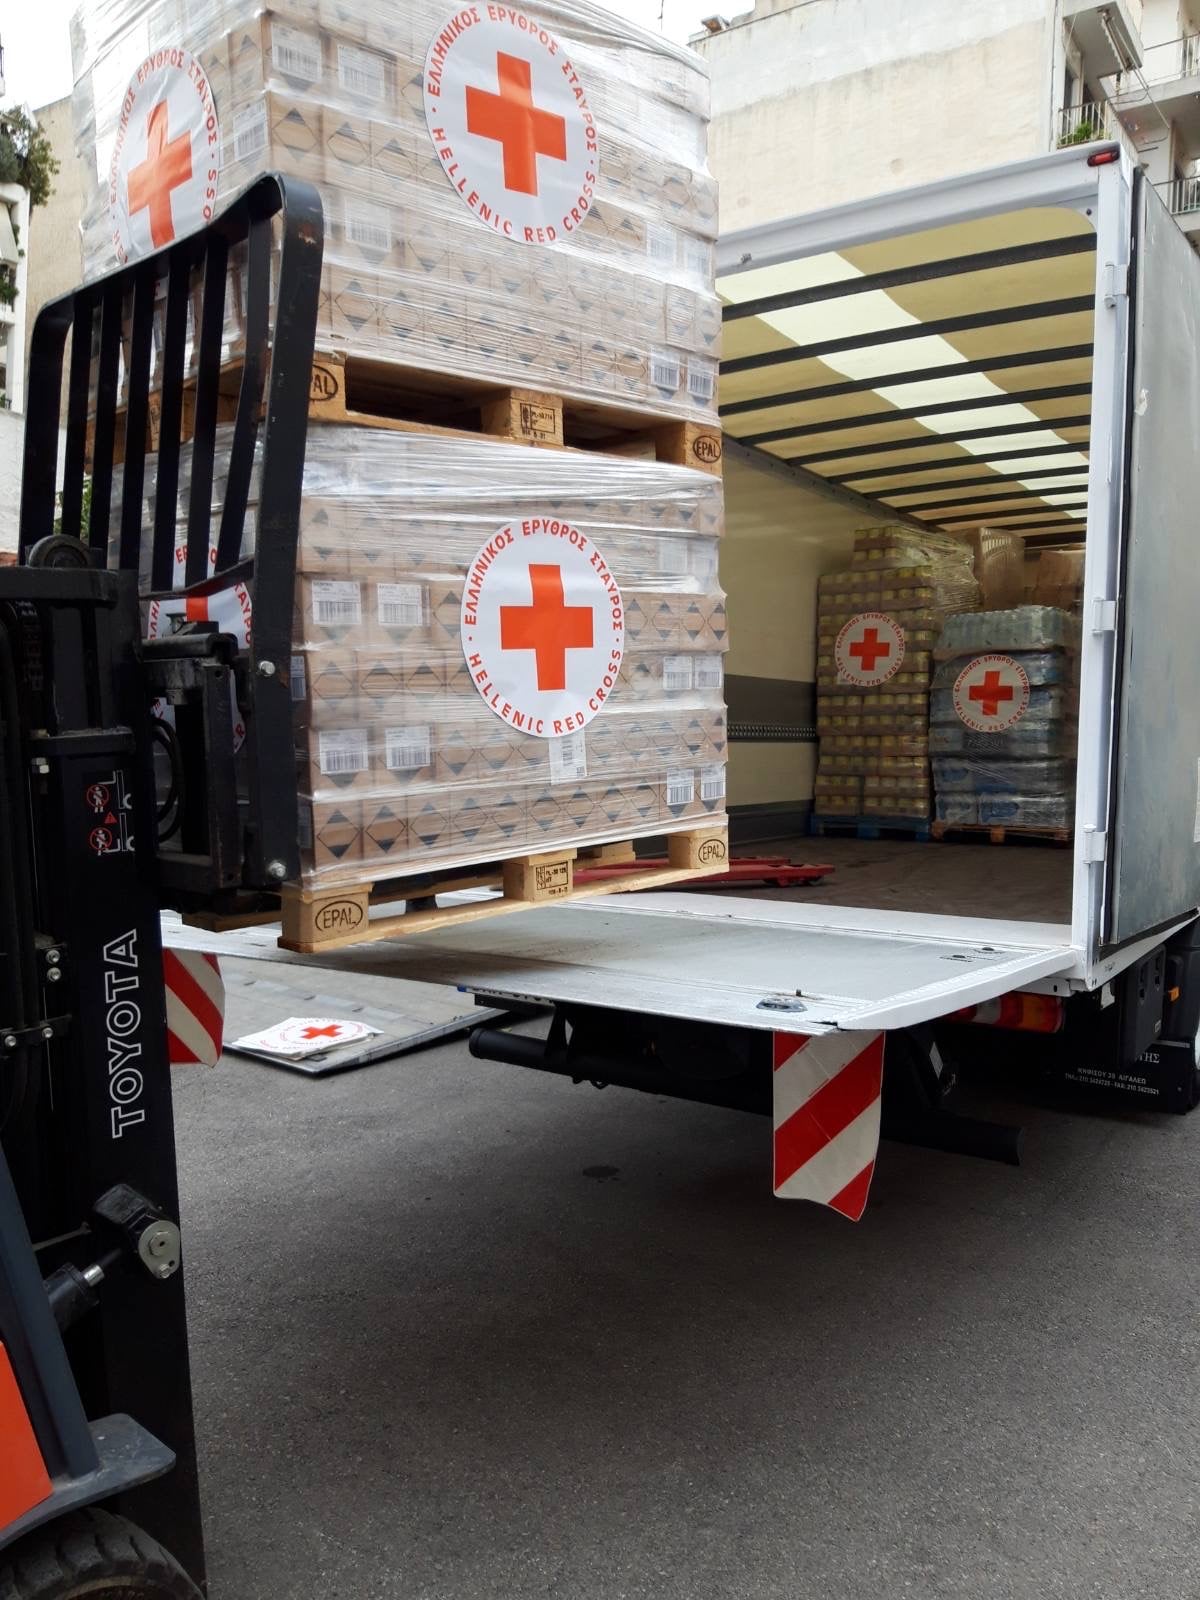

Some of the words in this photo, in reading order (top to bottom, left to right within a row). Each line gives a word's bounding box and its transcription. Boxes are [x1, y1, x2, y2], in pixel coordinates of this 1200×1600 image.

[427, 7, 481, 97] ΕΛΛΗΝΙΚΟΣ
[487, 5, 559, 56] ΕΡΥΘΡΟΣ
[562, 61, 597, 152] ΣΤΑΥΡΟΣ
[432, 128, 512, 235] HELLENIC
[524, 226, 556, 242] RED
[563, 171, 596, 231] CROSS
[696, 441, 718, 458] EPAL
[464, 528, 514, 625] ΕΛΛΗΝΙΚΟΣ
[522, 519, 588, 551] ΕΡΥΘΡΟΣ
[590, 552, 622, 630] ΣΤΑΥΡΟΣ
[469, 653, 544, 734] HELLENIC
[553, 712, 585, 734] RED
[589, 649, 621, 711] CROSS
[702, 844, 722, 860] EPAL
[323, 907, 356, 929] EPAL
[103, 928, 145, 1139] TOYOTA
